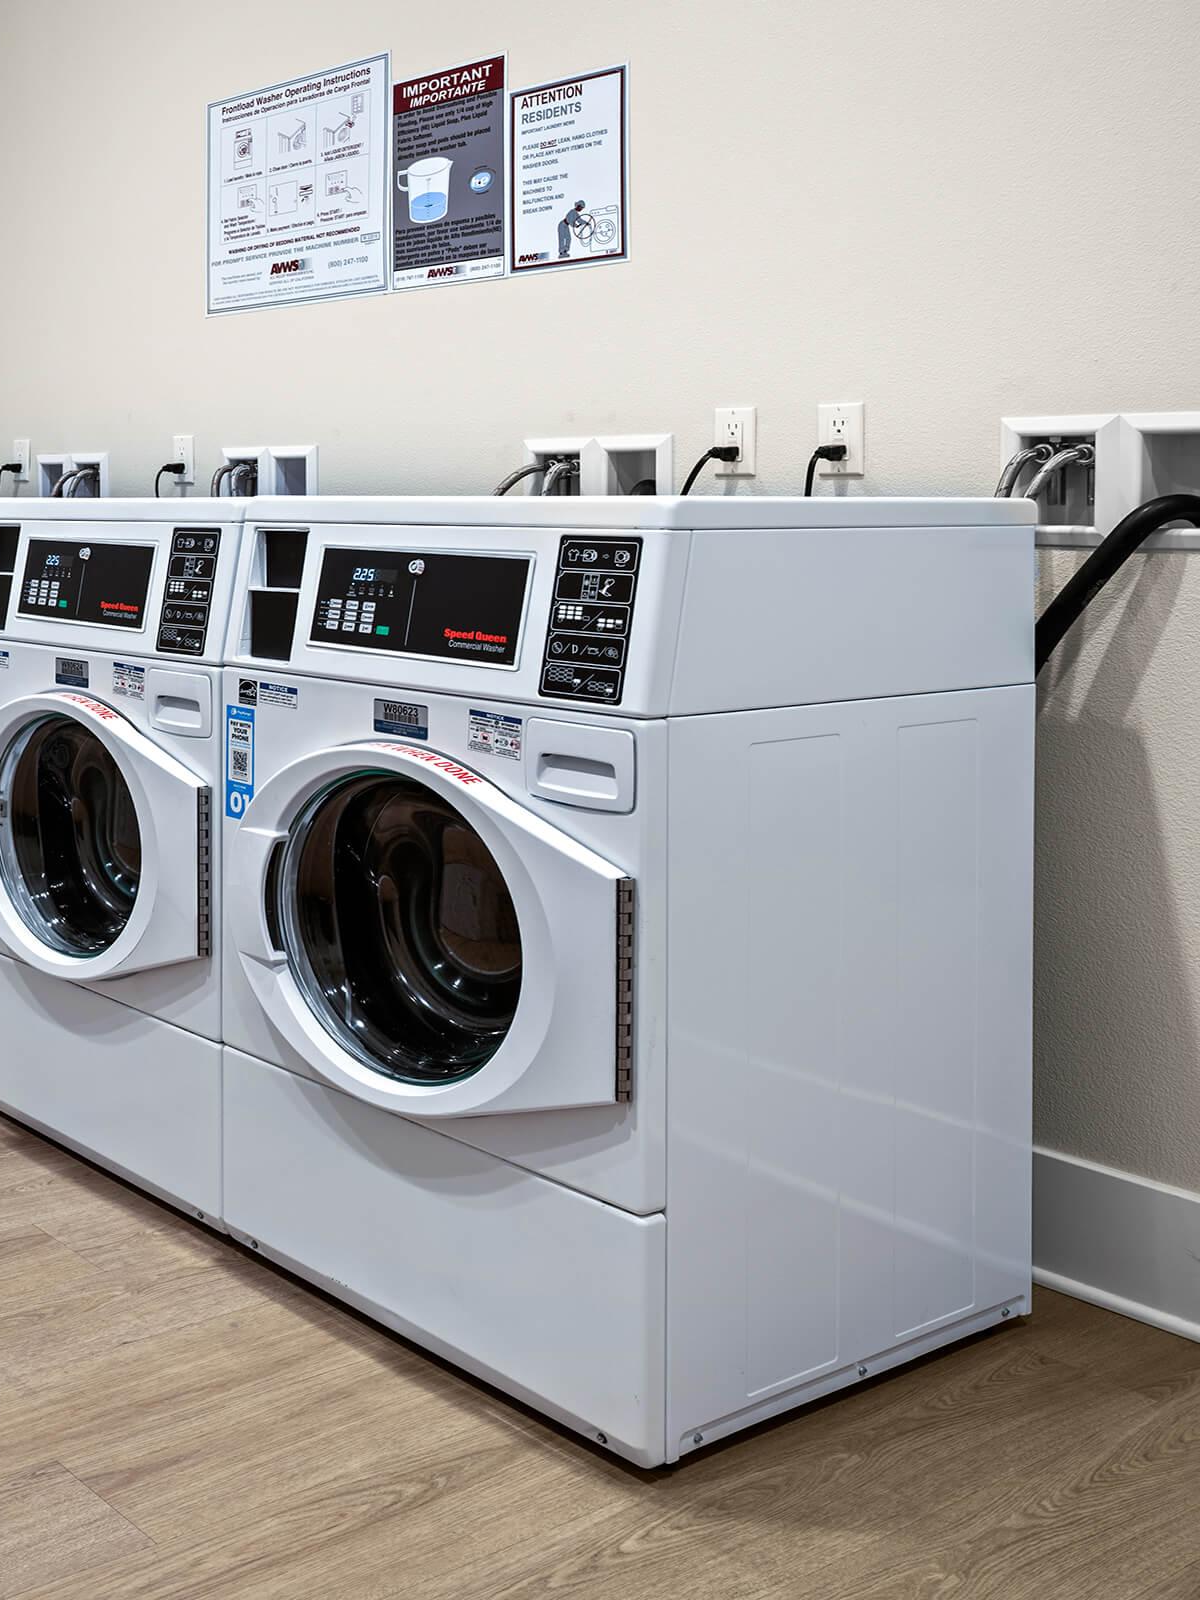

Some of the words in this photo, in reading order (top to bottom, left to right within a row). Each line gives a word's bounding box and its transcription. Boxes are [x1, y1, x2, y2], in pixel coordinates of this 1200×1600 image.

[403, 64, 493, 98] IMPORTANT
[221, 99, 255, 115] Frontload
[255, 92, 284, 106] Washer
[285, 81, 322, 98] Operating
[323, 67, 371, 87] Instructions
[410, 80, 486, 108] IMPORTANTE
[521, 84, 583, 109] ATTENTION
[222, 111, 253, 123] Instrucciones
[261, 102, 286, 114] Operacion
[286, 98, 298, 107] para
[299, 91, 325, 103] Lavadoras
[334, 84, 350, 92] Carga
[351, 78, 371, 88] Frontal
[521, 102, 582, 124] RESIDENTS
[522, 143, 539, 151] PLEASE
[586, 129, 608, 138] CLOTHES
[530, 151, 544, 159] PLACE
[522, 187, 545, 195] MACHINES
[522, 195, 554, 205] MALFUNCTION
[223, 257, 244, 265] PROMPT
[245, 253, 268, 261] SERVICE
[269, 249, 292, 257] PROVIDE
[305, 241, 331, 251] MACHINE
[333, 237, 359, 247] NUMBER
[270, 260, 299, 275] AVWS
[427, 267, 454, 278] AVWS
[100, 601, 118, 610] Speed
[119, 602, 138, 612] Queen
[103, 609, 123, 618] Commercial
[123, 611, 137, 619] Washer
[443, 627, 474, 641] Speed
[475, 631, 507, 643] Queen
[448, 639, 481, 650] Commercial
[482, 643, 505, 653] Washer
[383, 703, 419, 718] W80623
[231, 733, 249, 742] PHONE
[233, 727, 248, 735] YOUR
[434, 758, 483, 785] DONE
[230, 791, 249, 813] 01
